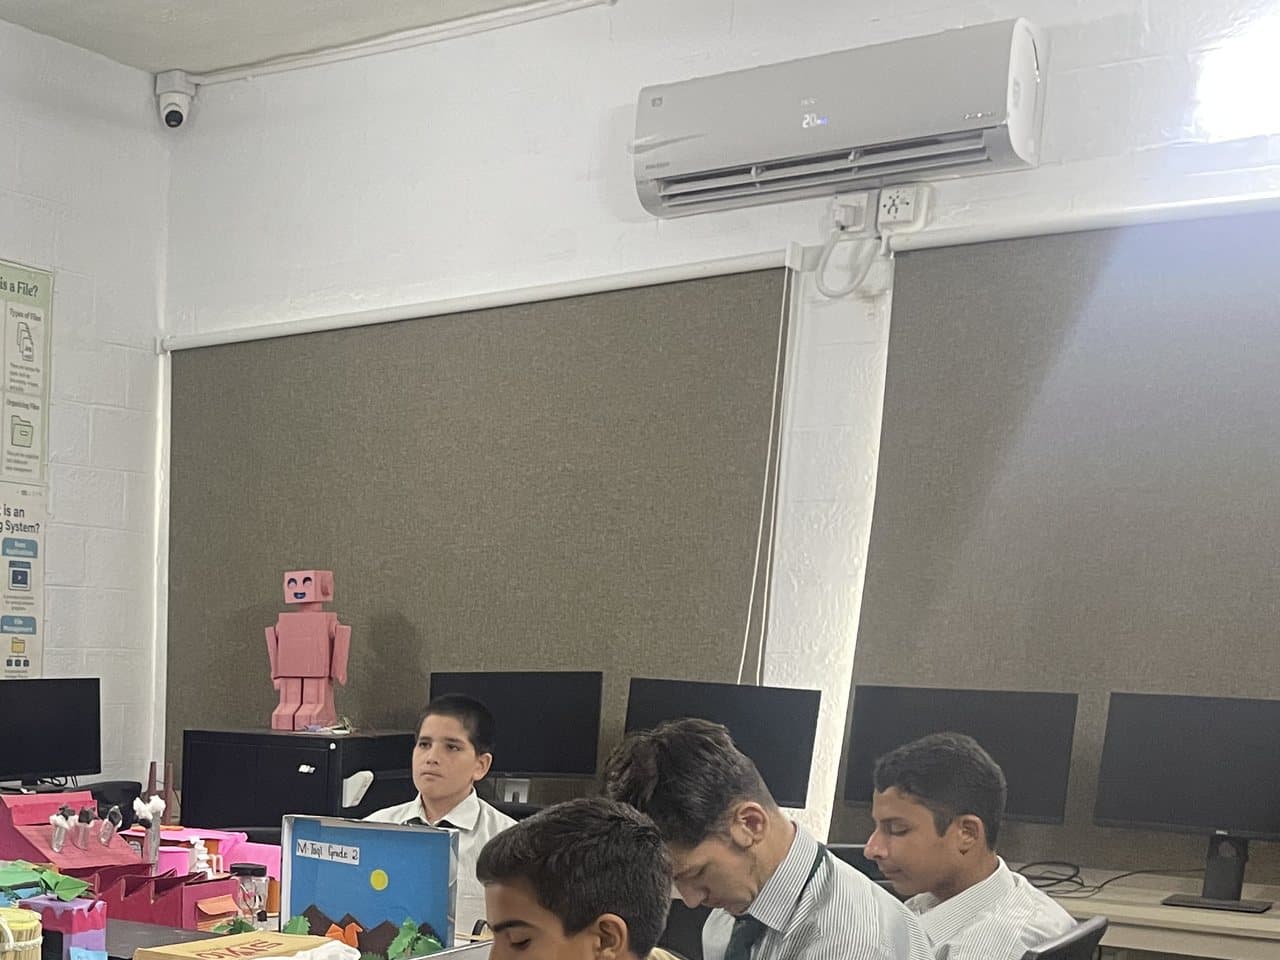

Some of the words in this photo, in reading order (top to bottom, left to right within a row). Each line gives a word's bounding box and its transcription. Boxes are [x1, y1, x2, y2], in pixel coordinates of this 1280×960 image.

[0, 276, 8, 291] is
[9, 282, 16, 294] a
[17, 281, 39, 298] File?
[3, 504, 11, 517] is
[13, 506, 25, 518] an
[5, 520, 40, 534] System?
[352, 849, 359, 861] 2
